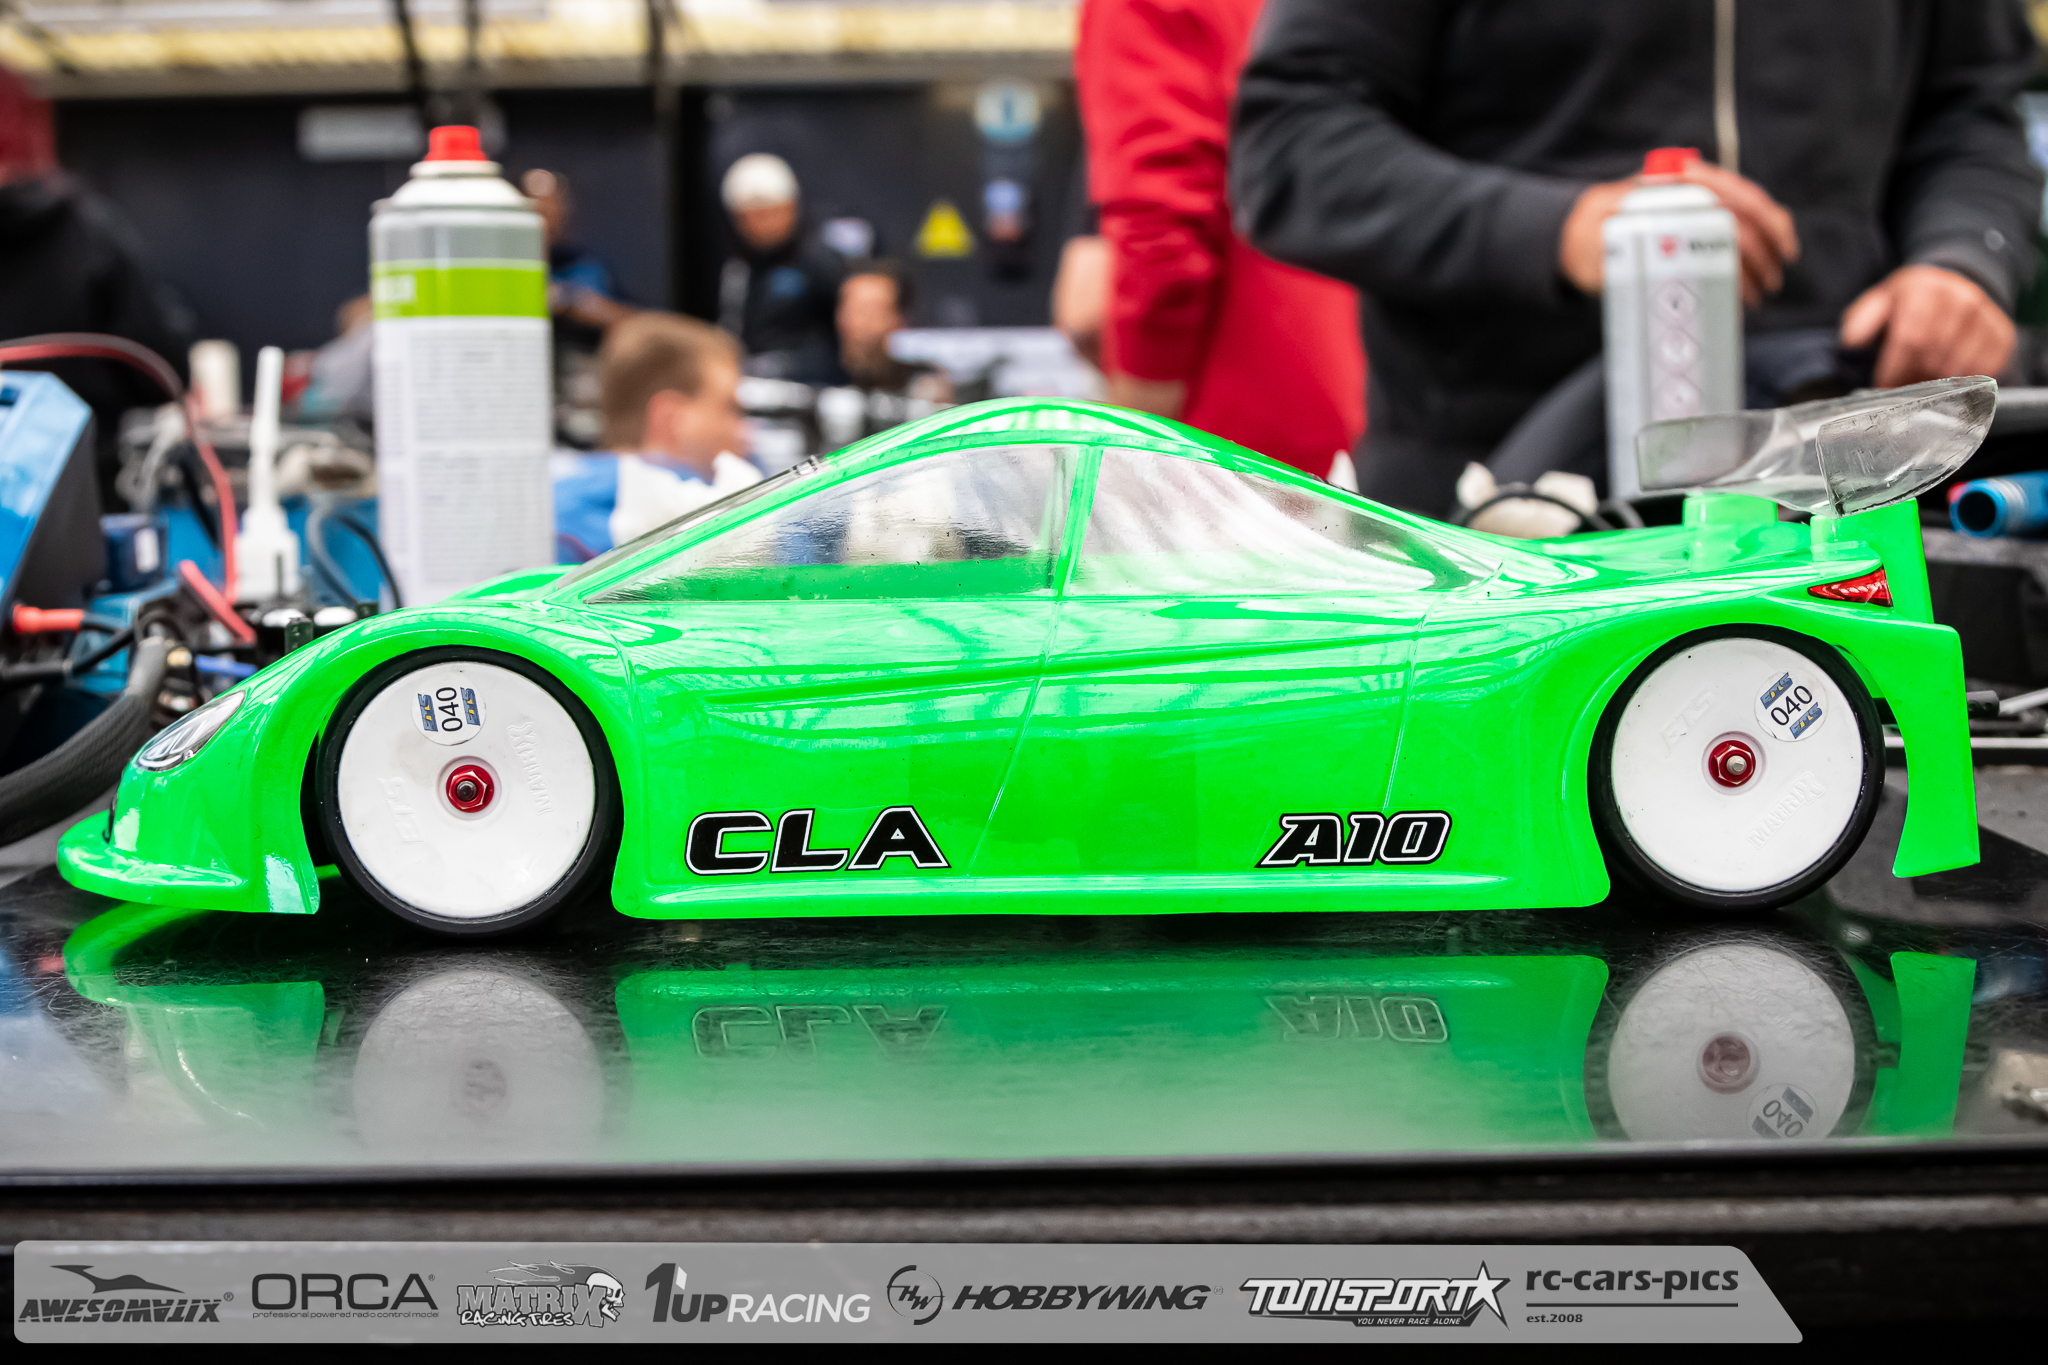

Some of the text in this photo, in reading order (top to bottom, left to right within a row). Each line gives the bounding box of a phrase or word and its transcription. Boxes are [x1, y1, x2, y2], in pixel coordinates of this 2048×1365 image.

[435, 686, 464, 732] 040
[1770, 685, 1813, 726] 040
[684, 805, 952, 876] CLA
